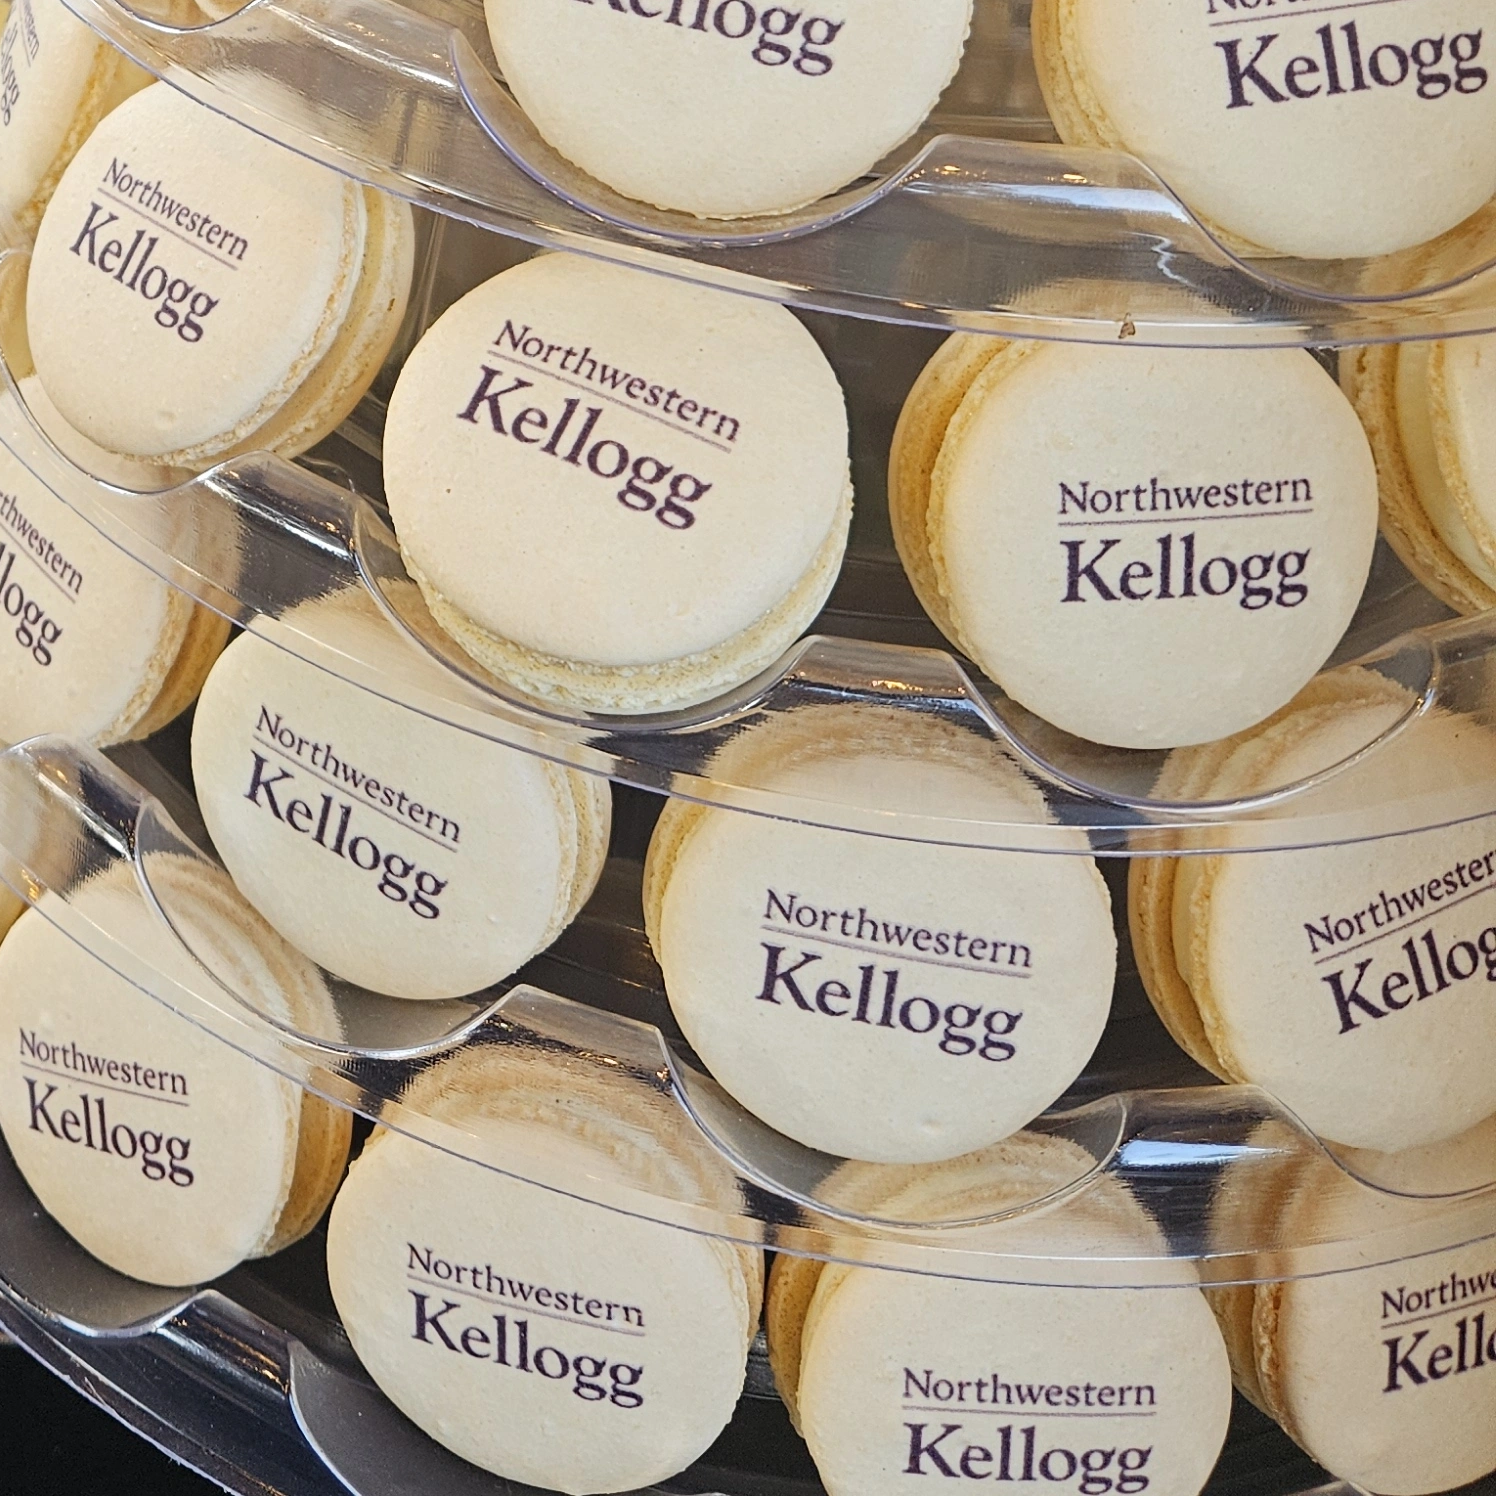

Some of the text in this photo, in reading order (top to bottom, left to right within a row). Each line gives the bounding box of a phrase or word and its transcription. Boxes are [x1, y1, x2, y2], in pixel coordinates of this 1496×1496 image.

[1212, 16, 1489, 110] Kellogg
[102, 156, 249, 261] Northwestern
[69, 200, 221, 344] Kellogg
[492, 318, 741, 444] Northwestern
[456, 364, 713, 531] Kellogg
[1057, 476, 1314, 515] Northwestern
[1059, 530, 1312, 611] Kellogg
[255, 704, 462, 844] Northwestern
[242, 748, 449, 921] Kellogg
[763, 888, 1033, 969] Northwestern
[1303, 849, 1496, 955] Northwester
[755, 942, 1024, 1062] Kellogg
[18, 1026, 189, 1096] Northwestern
[22, 1075, 195, 1188] Kellogg
[406, 1241, 646, 1328] Northwestern
[407, 1288, 645, 1409] Kellogg
[902, 1366, 1157, 1407] Northwestern
[901, 1422, 1154, 1496] Kellogg
